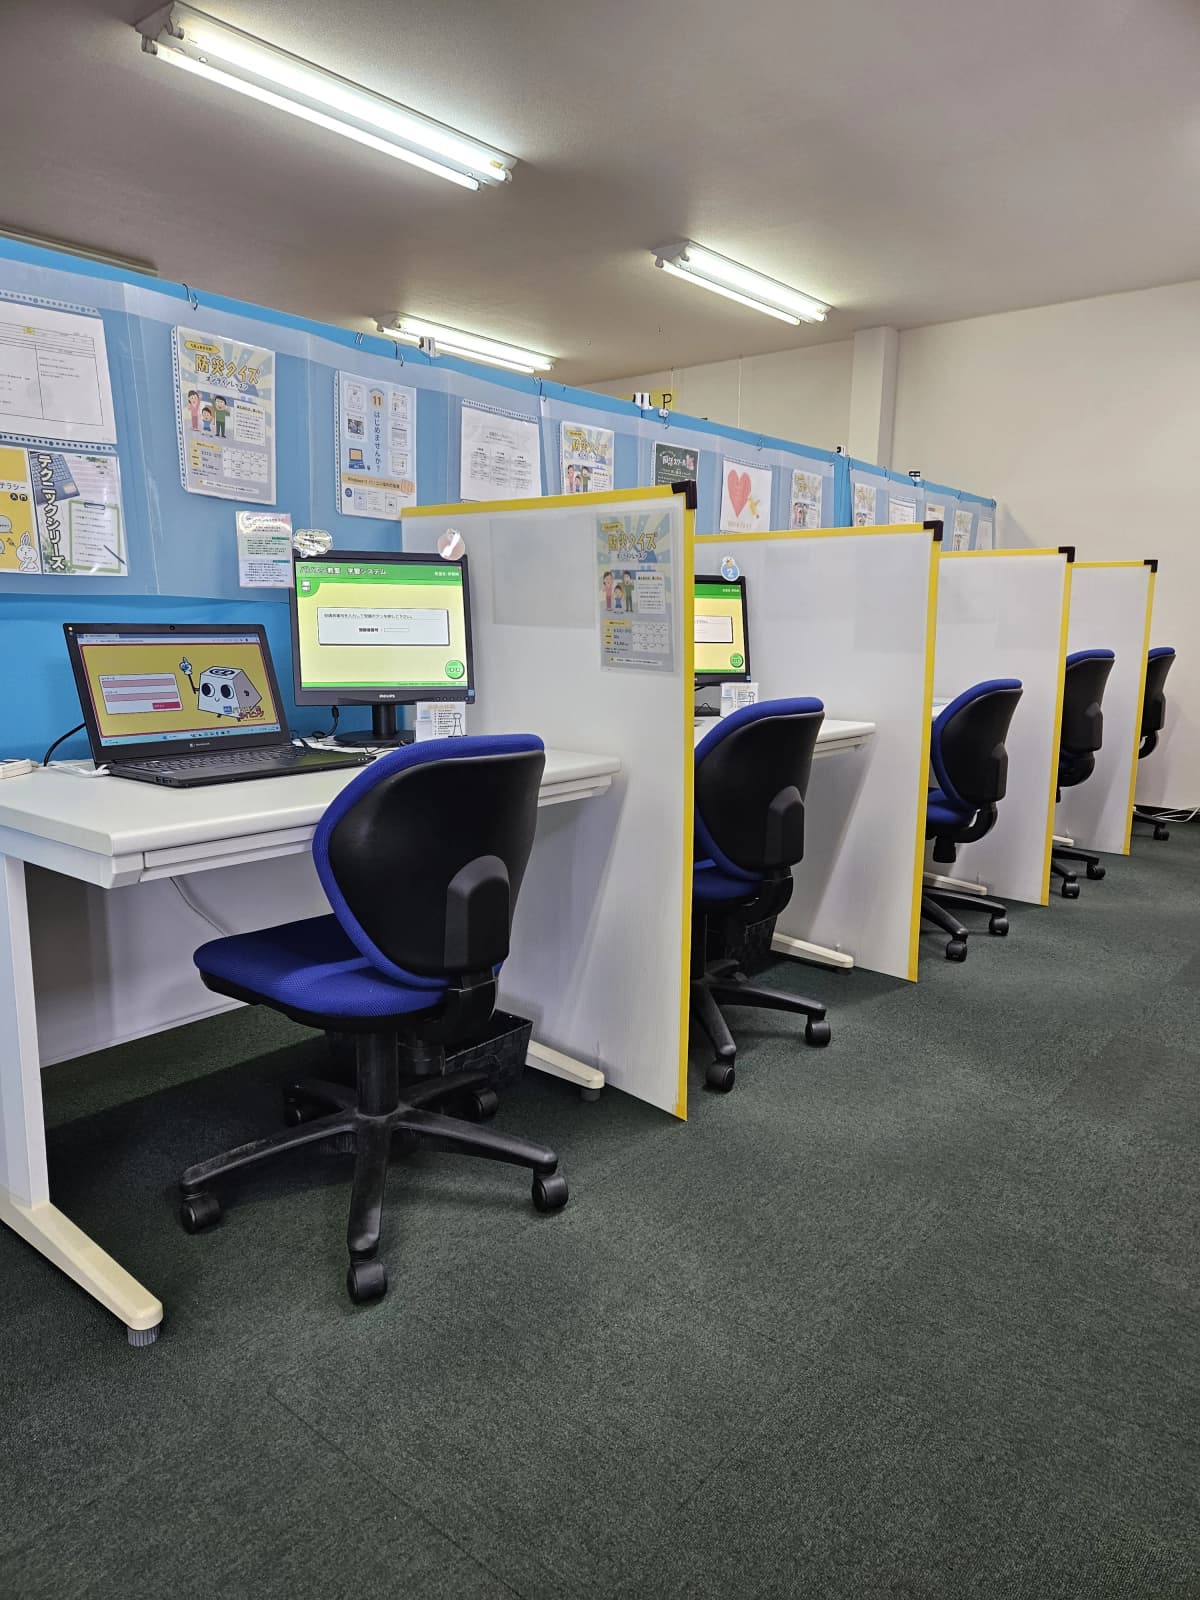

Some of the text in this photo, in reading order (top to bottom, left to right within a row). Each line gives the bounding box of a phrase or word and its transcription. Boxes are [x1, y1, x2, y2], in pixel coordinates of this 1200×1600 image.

[38, 454, 65, 570] テクニックシリーズ
